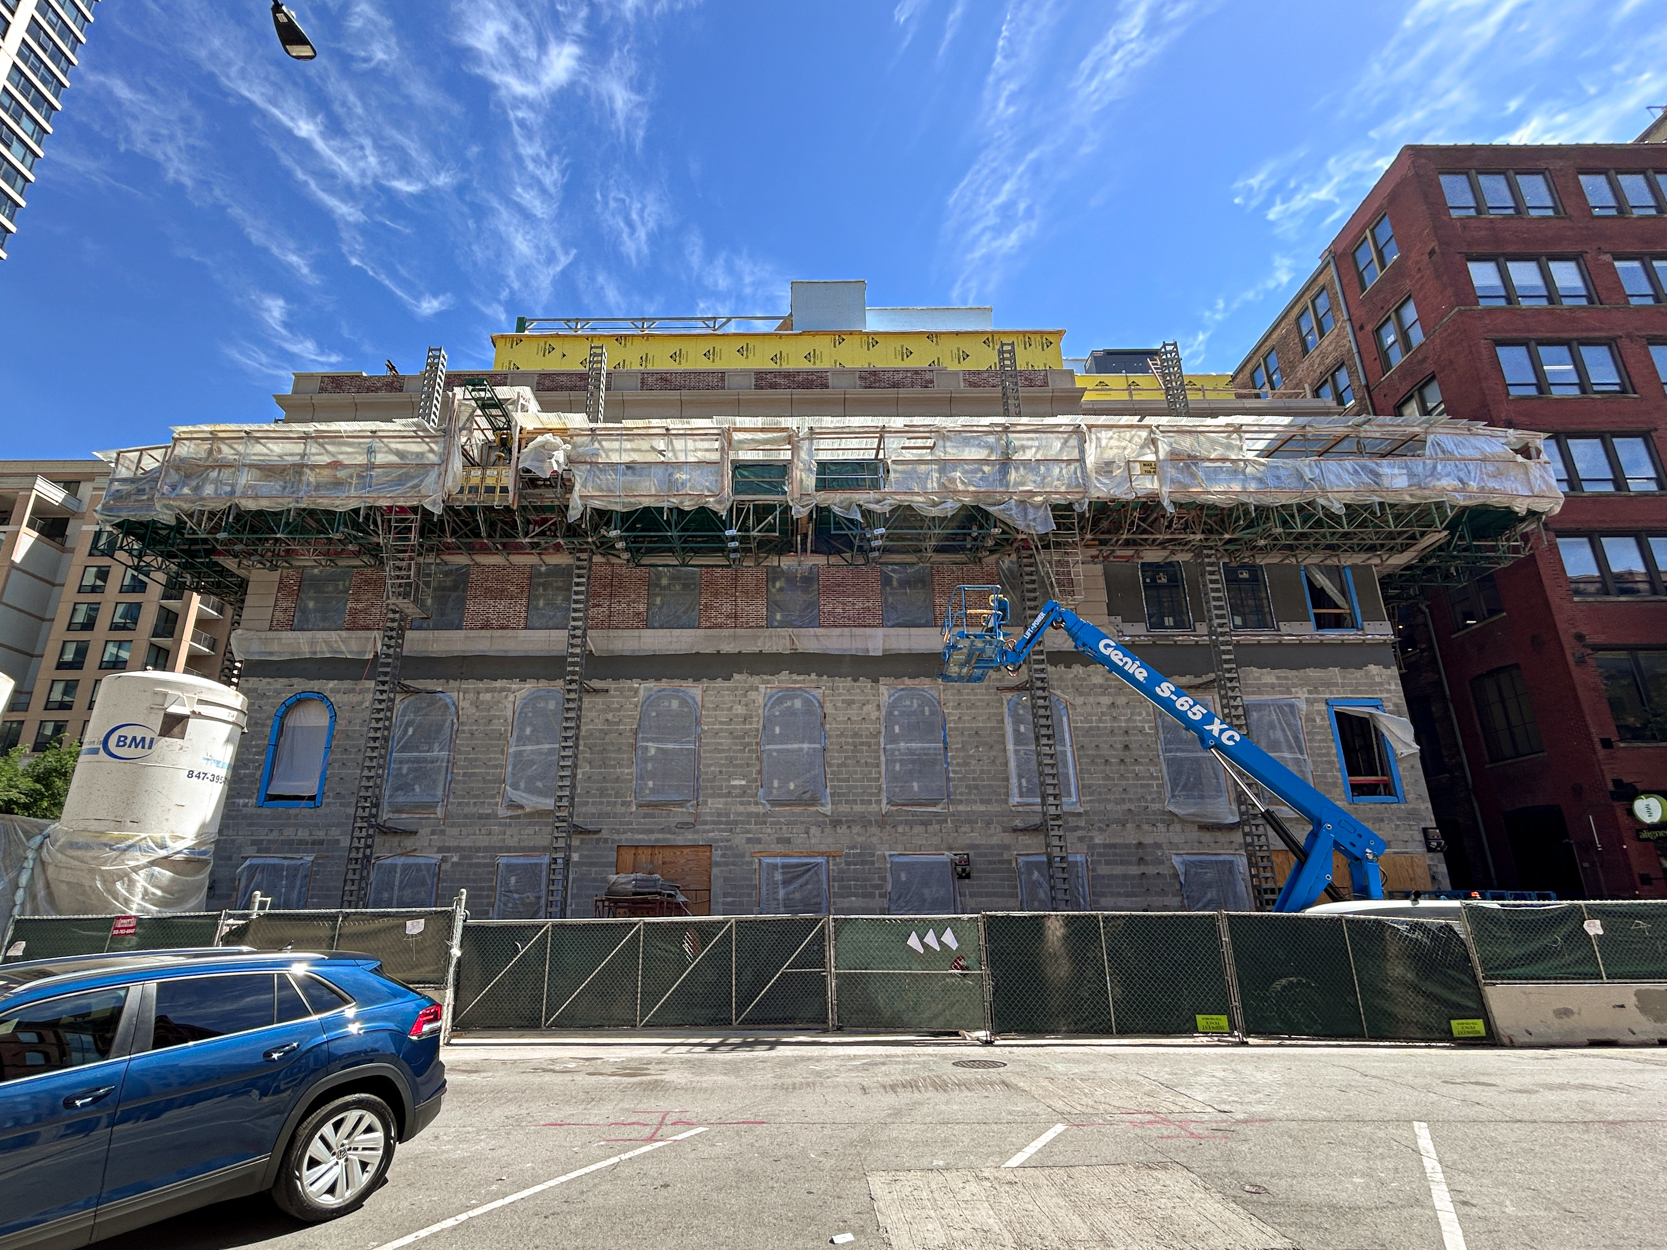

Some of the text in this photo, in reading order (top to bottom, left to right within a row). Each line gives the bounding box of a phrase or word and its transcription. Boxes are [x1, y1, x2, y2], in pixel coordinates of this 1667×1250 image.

[1098, 638, 1240, 746] Genie S-65 XC
[115, 734, 155, 750] BMI
[1638, 830, 1667, 840] aligne
